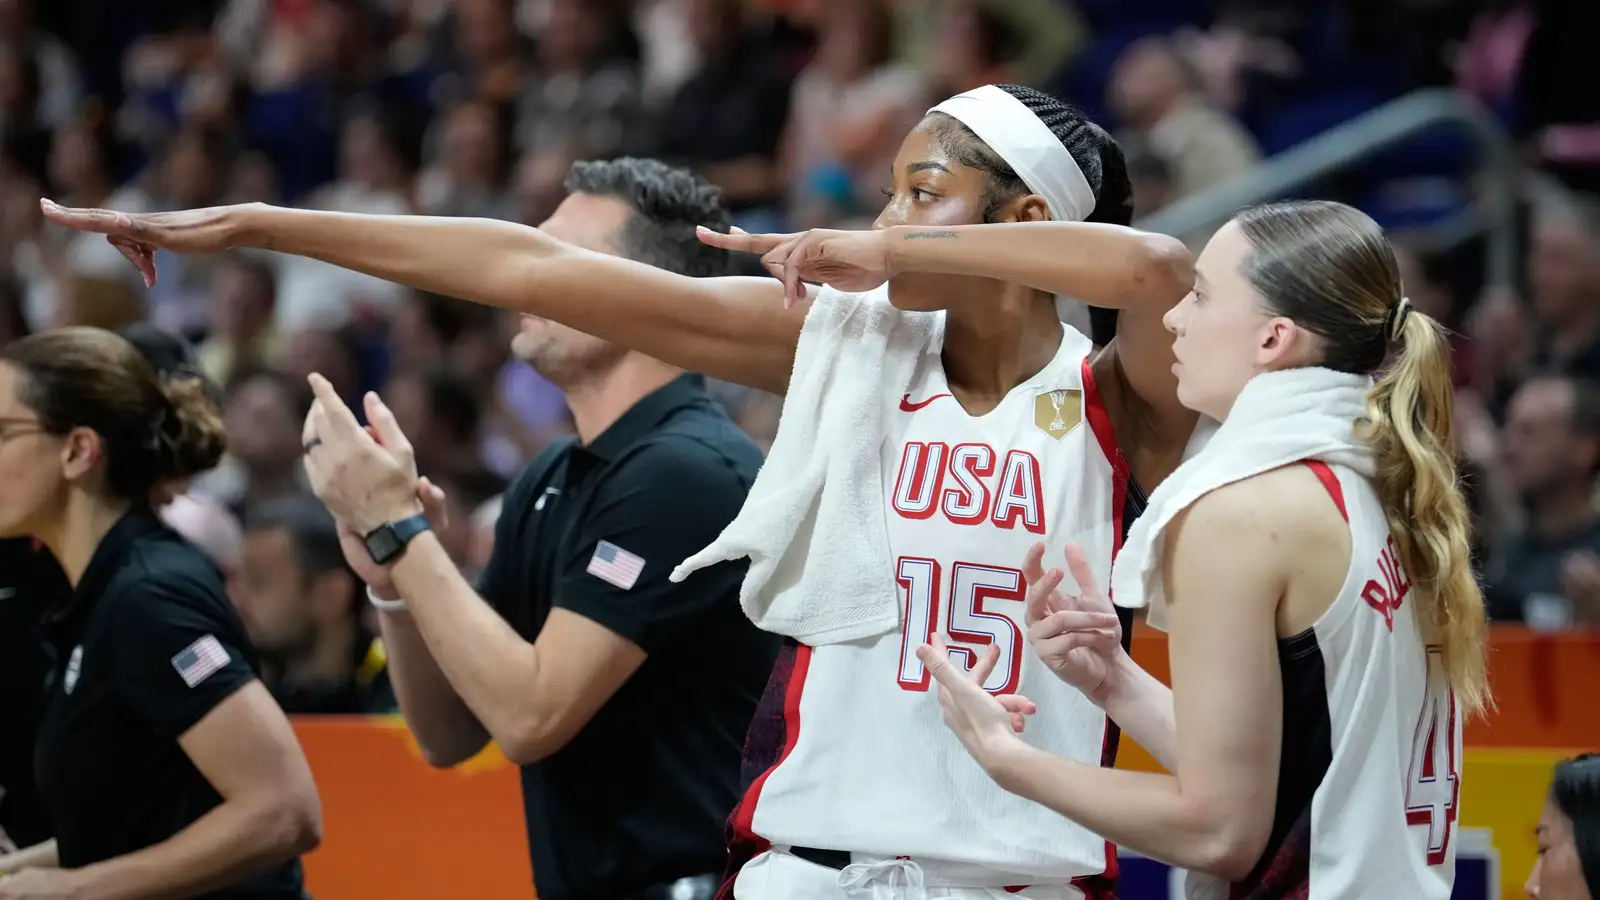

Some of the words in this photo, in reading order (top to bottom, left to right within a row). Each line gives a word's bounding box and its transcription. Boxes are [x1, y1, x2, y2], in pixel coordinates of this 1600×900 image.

[893, 442, 1046, 534] USA
[897, 556, 1027, 696] 15
[1405, 645, 1458, 866] 4
